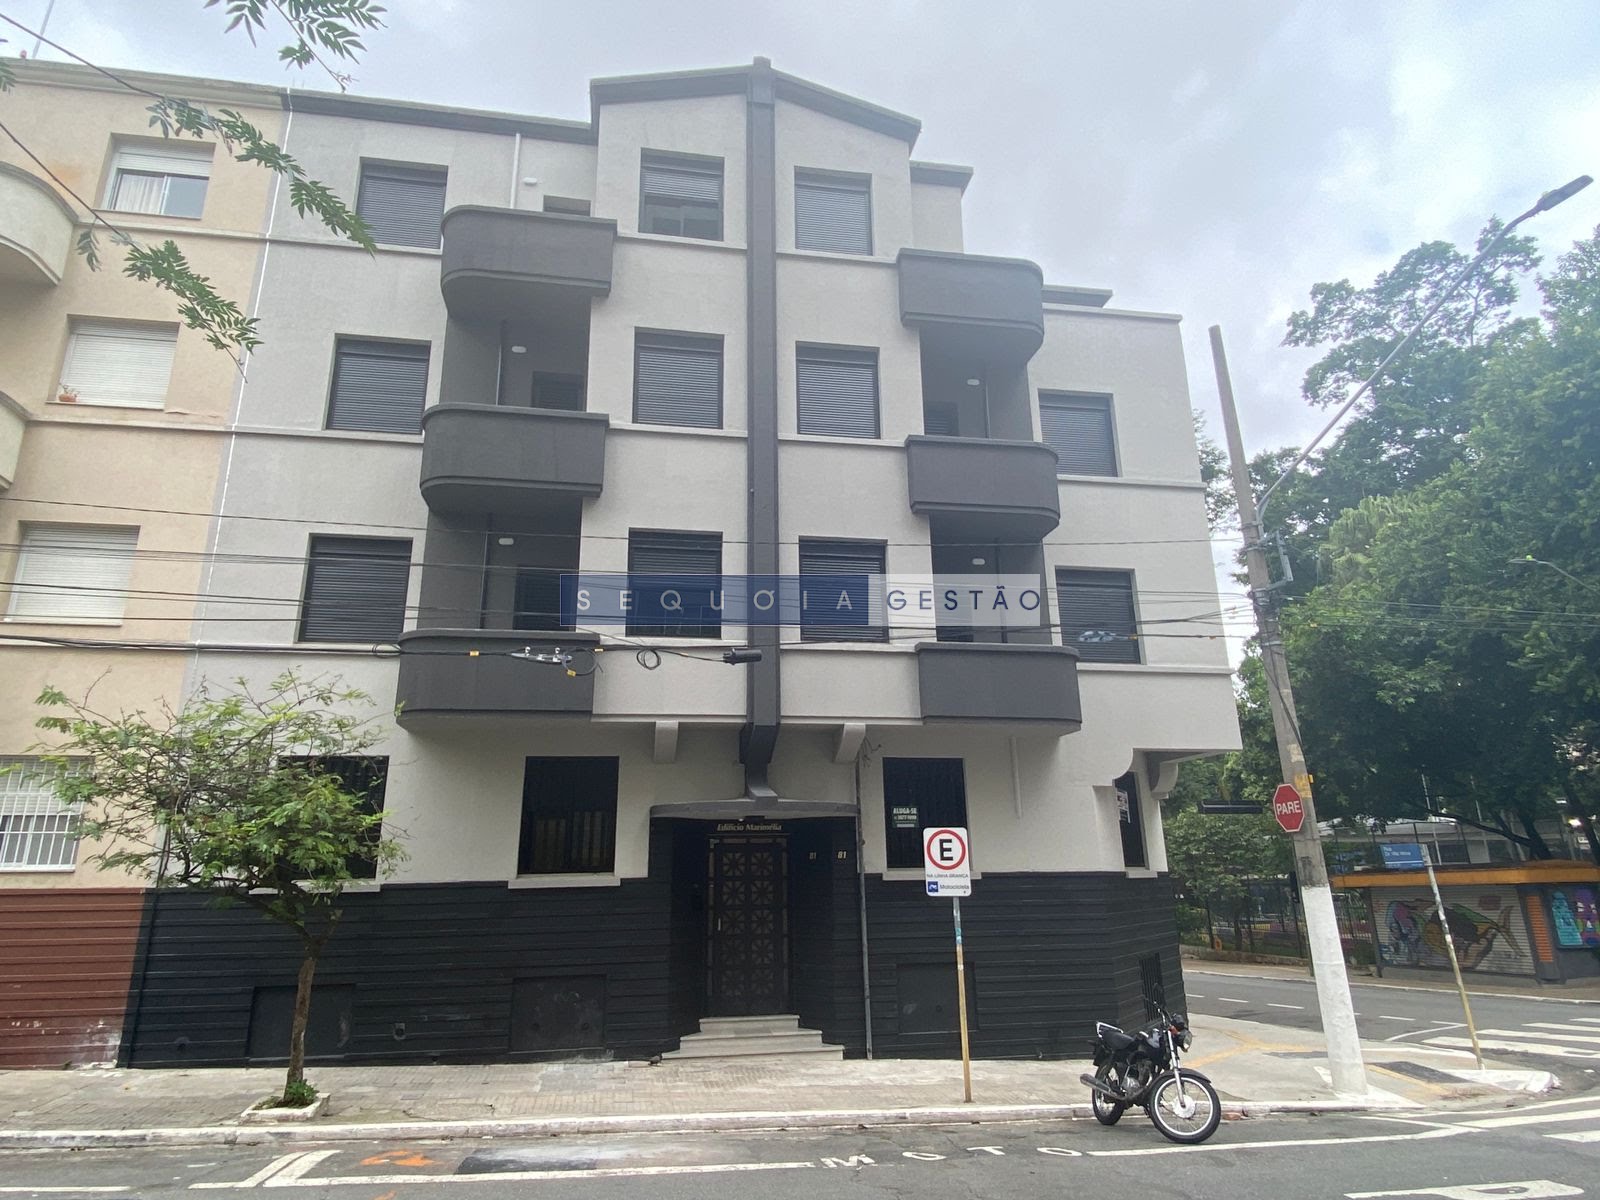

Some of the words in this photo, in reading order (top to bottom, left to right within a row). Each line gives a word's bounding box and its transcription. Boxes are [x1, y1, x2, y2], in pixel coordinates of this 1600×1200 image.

[1276, 800, 1302, 815] PARE
[939, 838, 954, 861] E
[820, 1146, 1083, 1168] MOTO
